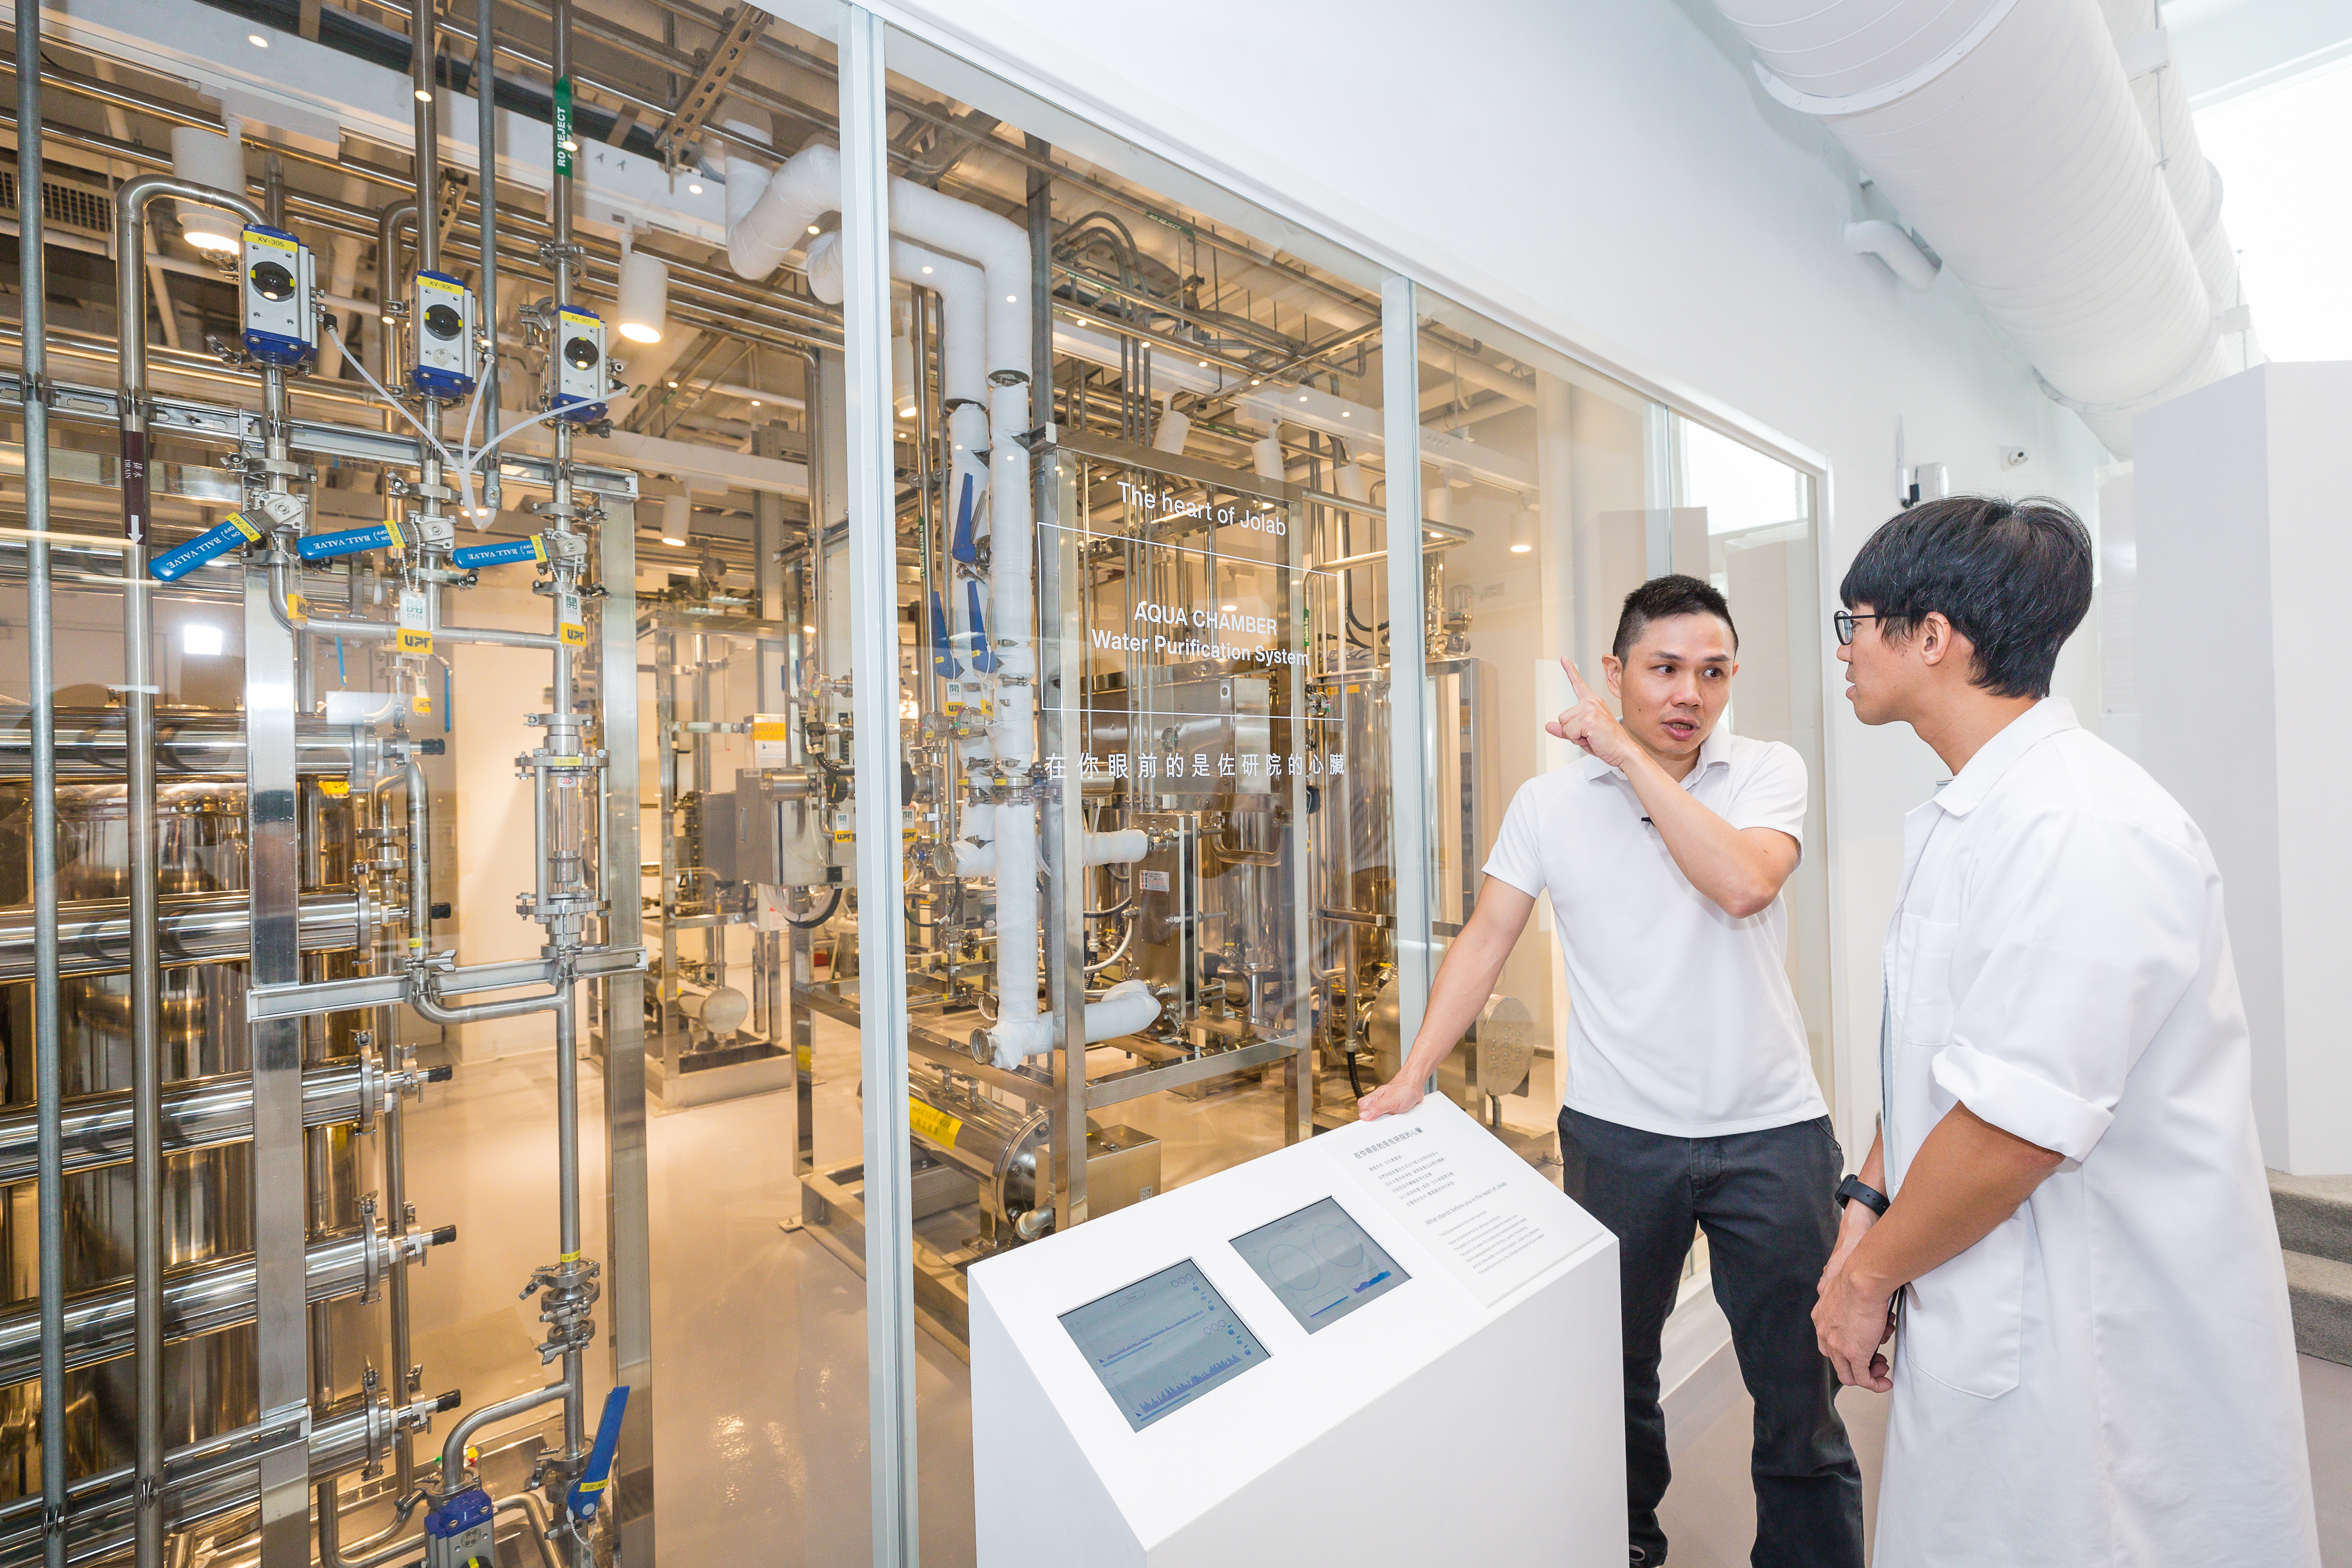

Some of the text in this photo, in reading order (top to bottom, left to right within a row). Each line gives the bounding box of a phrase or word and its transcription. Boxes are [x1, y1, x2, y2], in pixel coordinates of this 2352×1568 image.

[557, 107, 566, 167] RO REJECT
[257, 236, 285, 247] XV-305
[429, 280, 452, 291] XV-306
[570, 315, 591, 324] XV-307
[1116, 481, 1286, 536] The heart of Jolab
[232, 516, 255, 537] HV-304
[388, 524, 401, 544] HV-305
[313, 535, 372, 549] BALL VALVE
[534, 539, 544, 558] HV-306
[166, 537, 222, 569] BALL VALVE
[468, 548, 518, 560] BALL VALVE
[406, 598, 422, 613] 開
[566, 595, 577, 610] 開
[1134, 602, 1277, 636] AQUA CHAMBER
[1091, 628, 1310, 667] Water Purification System
[949, 684, 959, 693] 開
[1045, 752, 1345, 781] 在你眼前的是佐研院的心臟
[902, 811, 913, 819] 開
[1354, 1127, 1423, 1158] 在你眼前的是佐研院的心臟
[1437, 1210, 1452, 1219] stands
[1450, 1204, 1465, 1212] before
[1481, 1228, 1493, 1236] products
[1487, 1233, 1501, 1242] producing
[1492, 1258, 1506, 1266] ensuring
[1517, 1243, 1530, 1251] standard
[584, 1482, 605, 1490] HV-303
